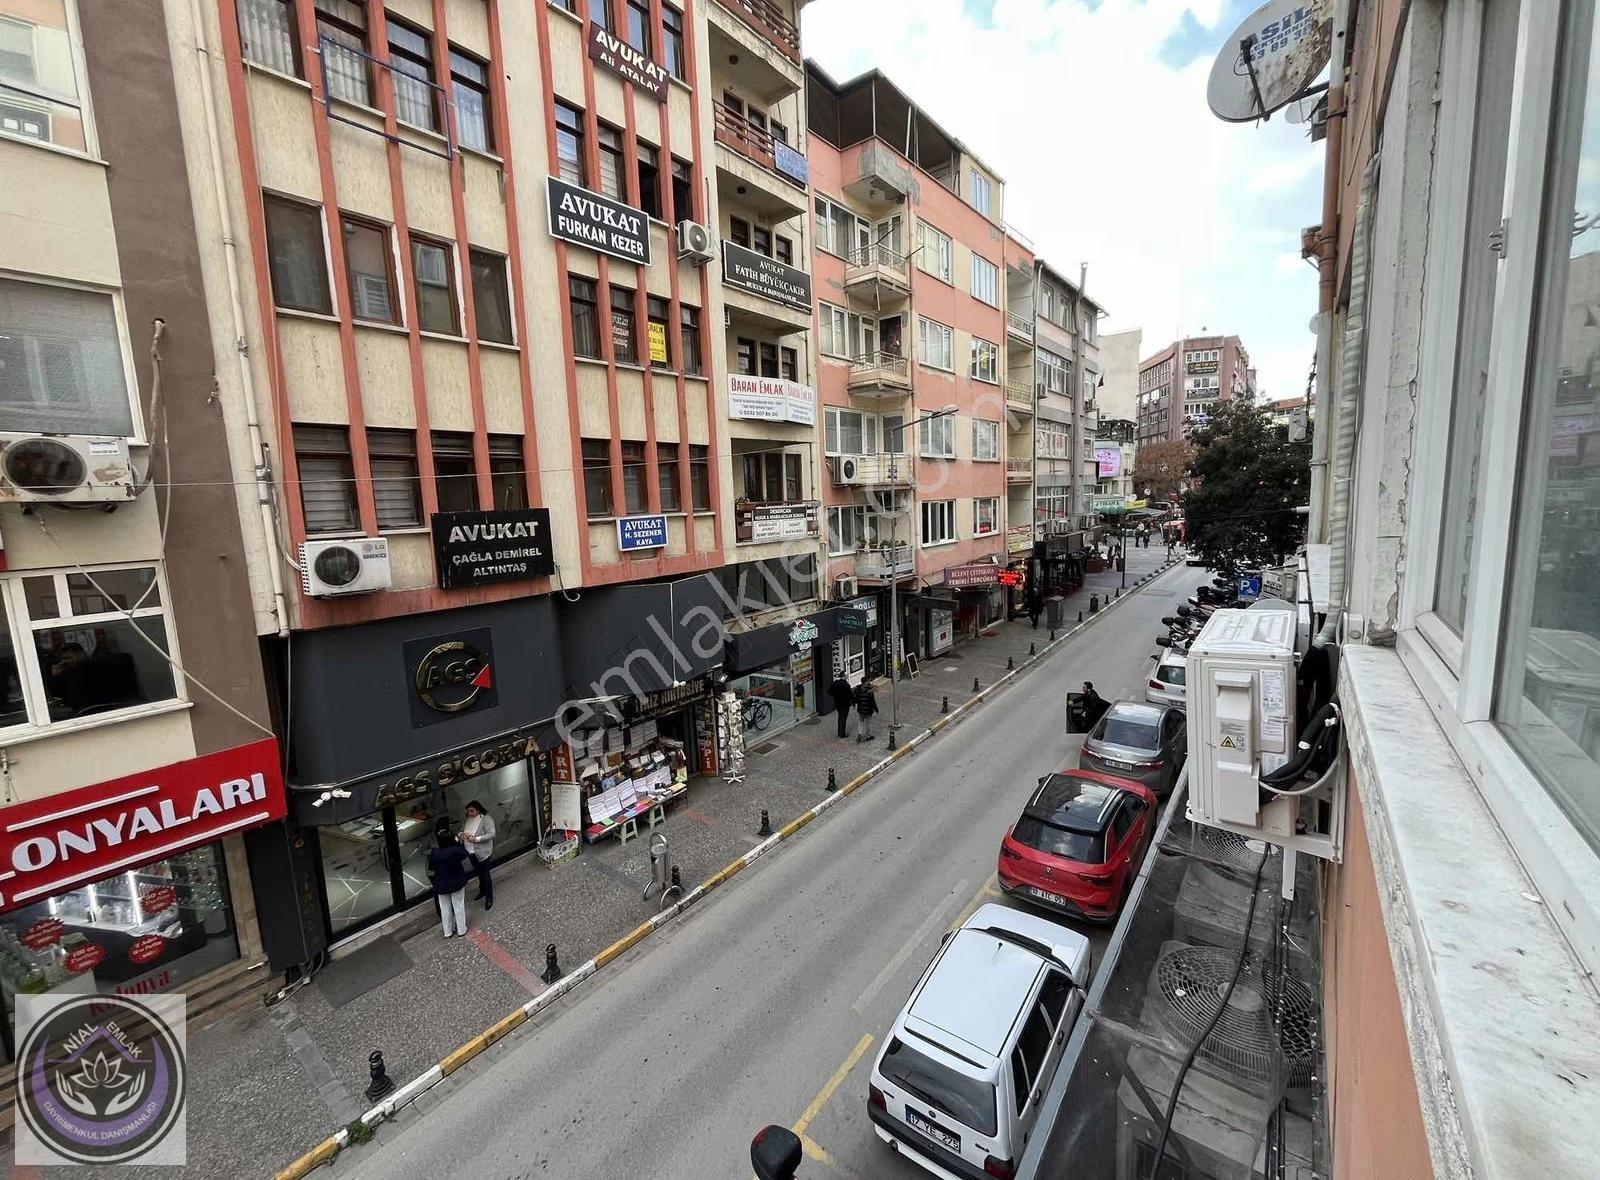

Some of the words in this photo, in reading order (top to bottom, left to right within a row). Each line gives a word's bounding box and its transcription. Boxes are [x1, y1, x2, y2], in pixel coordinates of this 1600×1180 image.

[595, 30, 667, 83] AVUKAT
[620, 64, 659, 93] ATALAY
[560, 192, 640, 236] AVUKAT
[558, 216, 606, 248] FURKAN
[611, 232, 644, 257] KEZER
[760, 261, 784, 276] AVUKAT
[735, 264, 758, 280] FATİH
[759, 273, 805, 297] BÜYÜKÇAKIR
[731, 378, 757, 393] BARAN
[760, 380, 784, 395] EMLAK
[449, 521, 538, 543] AVUKAT
[625, 519, 662, 531] AVUKAT
[633, 528, 662, 537] SEZENER
[636, 538, 653, 546] KAYA
[452, 550, 492, 566] ÇAĞLA
[495, 547, 542, 560] DEMİREL
[473, 562, 527, 577] ALTINTAŞ
[1240, 580, 1250, 590] P
[437, 735, 540, 786] SİGORTA
[0, 772, 267, 881] ONYALARI
